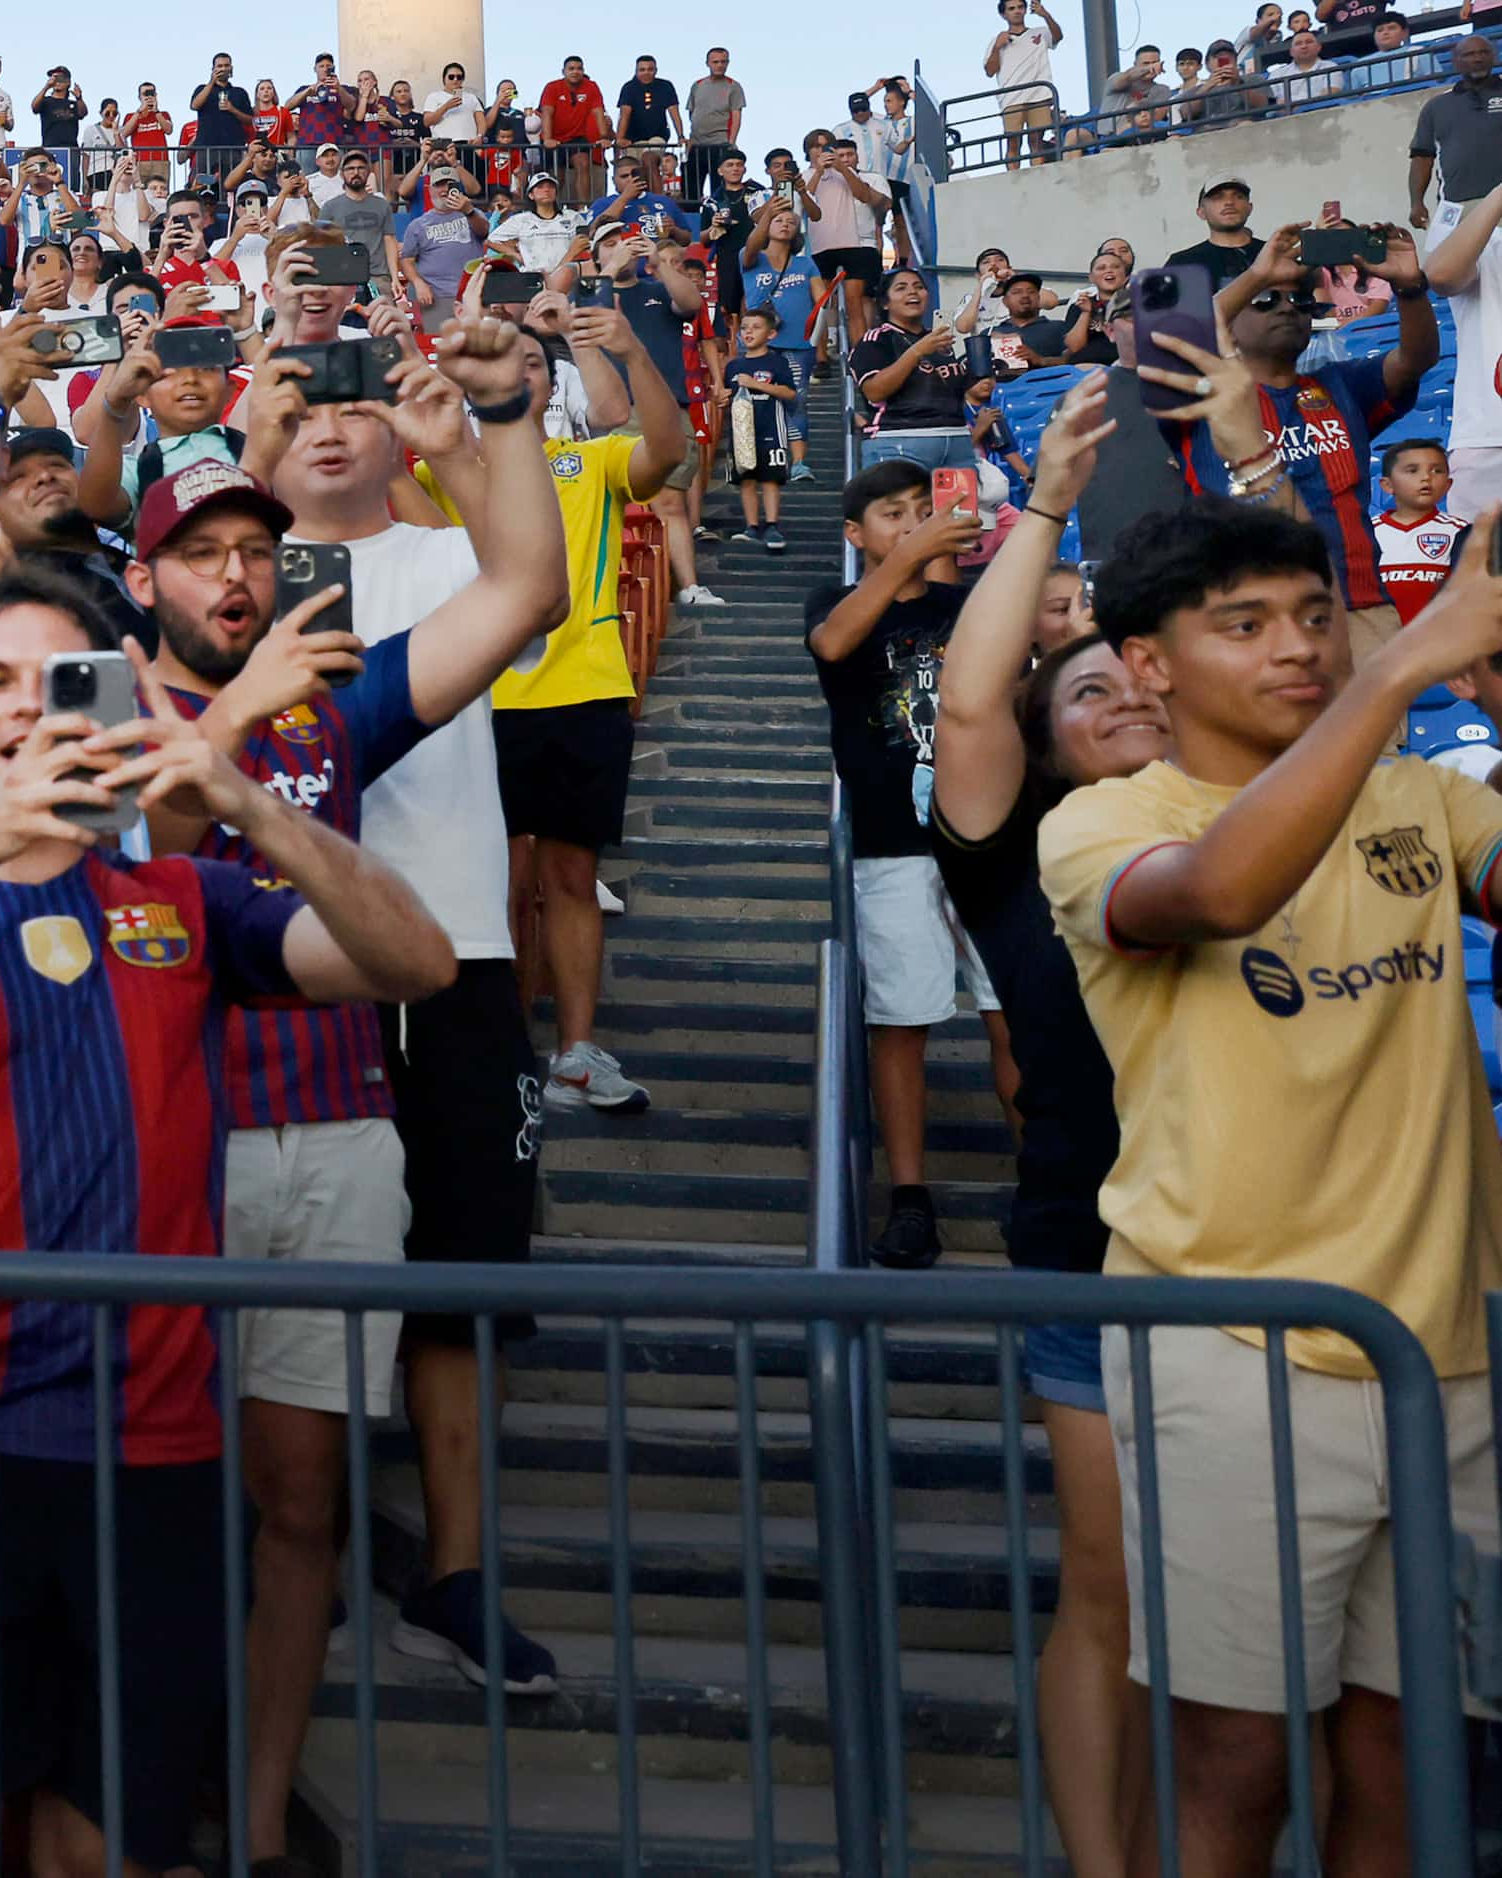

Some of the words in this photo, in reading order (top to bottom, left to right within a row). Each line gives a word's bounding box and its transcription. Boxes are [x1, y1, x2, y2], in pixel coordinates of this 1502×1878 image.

[755, 272, 773, 288] FC
[768, 449, 786, 467] 10
[916, 670, 934, 690] 10
[1307, 941, 1445, 1001] Spotify
